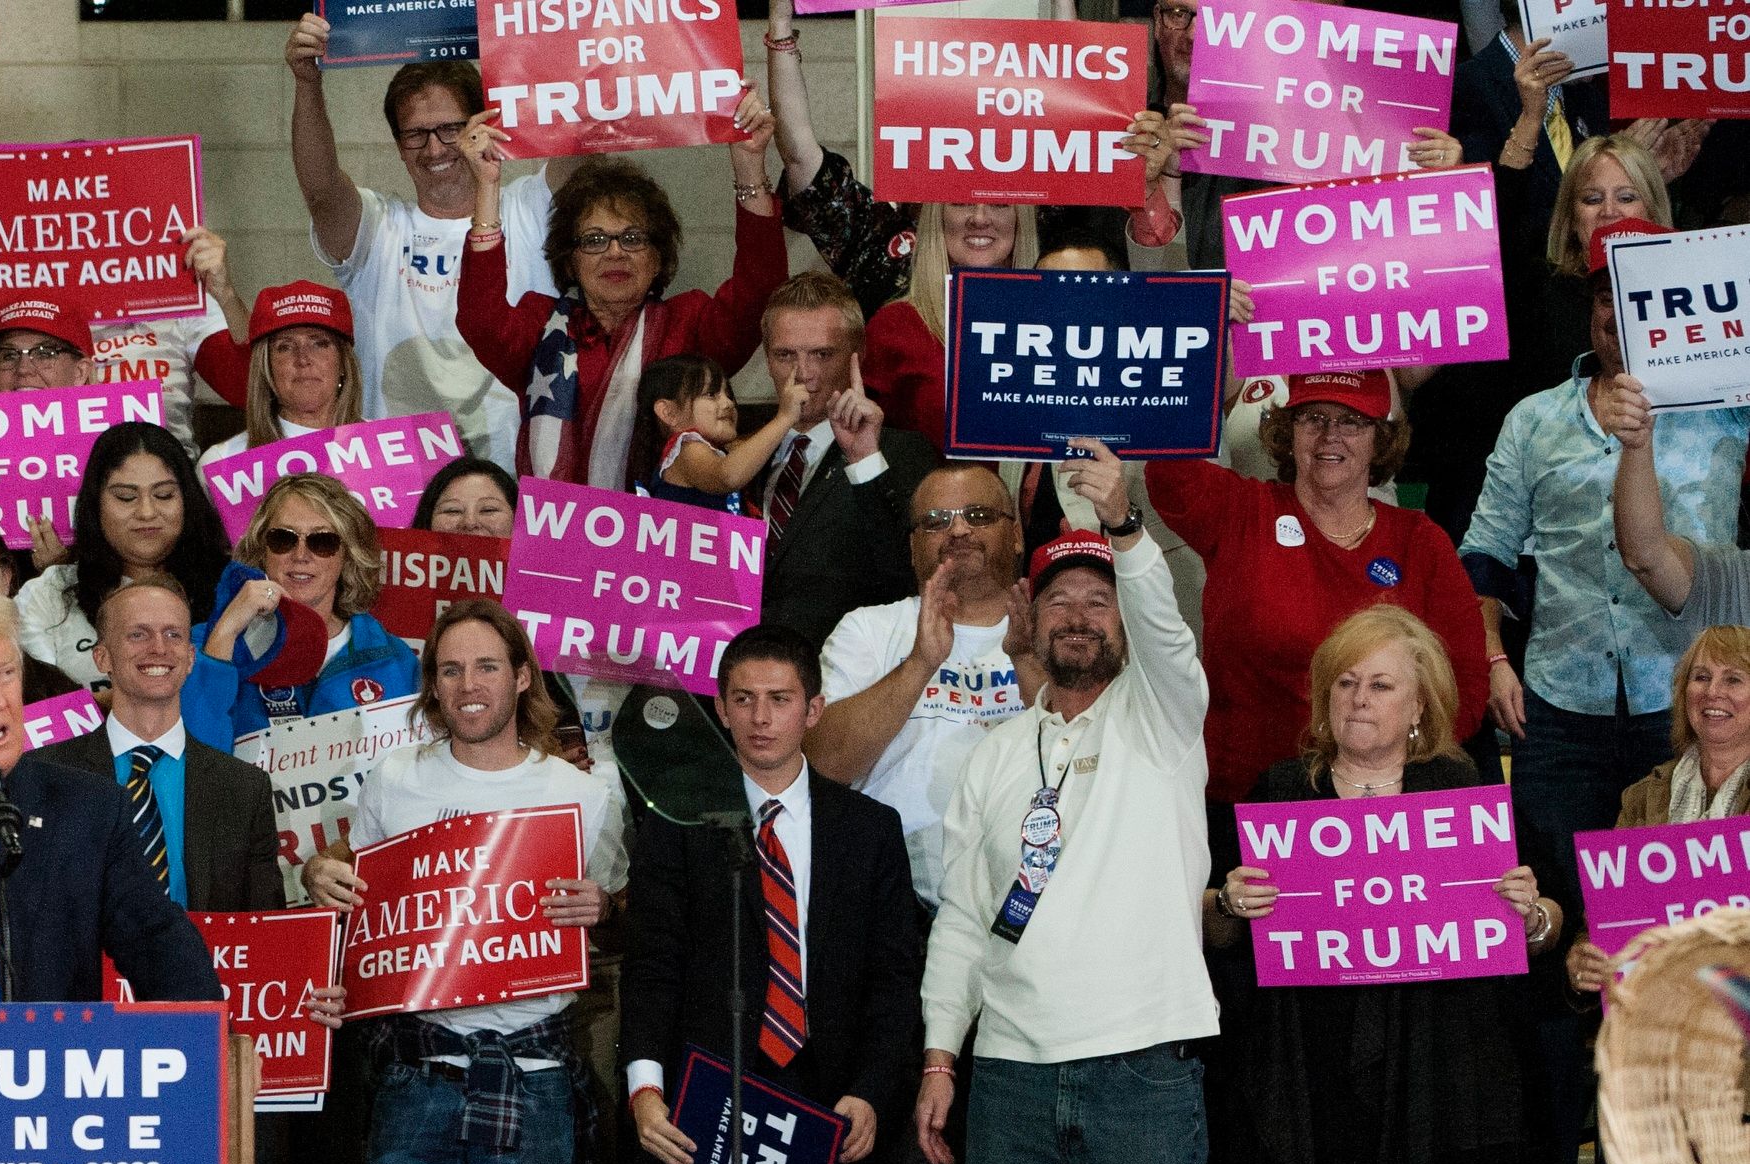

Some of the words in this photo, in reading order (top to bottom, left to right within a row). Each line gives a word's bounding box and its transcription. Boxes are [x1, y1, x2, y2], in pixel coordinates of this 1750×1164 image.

[346, 4, 383, 16] MAKE
[386, 0, 448, 14] AMERICA
[496, 0, 720, 38] HISPANICS
[1202, 5, 1453, 76] WOMEN
[1552, 17, 1588, 34] MAKE
[1708, 14, 1750, 42] FO
[430, 45, 468, 58] 2016
[577, 36, 646, 66] FOR
[893, 40, 1129, 81] HISPANICS
[1613, 52, 1750, 92] TRU
[489, 69, 741, 128] TRUMP
[976, 87, 1044, 117] FOR
[1276, 77, 1364, 115] FOR
[880, 126, 1140, 173] TRUMP
[27, 175, 110, 202] MAKE
[1228, 188, 1495, 252] WOMEN
[79, 254, 178, 284] AGAIN
[1317, 260, 1410, 295] FOR
[0, 302, 20, 317] MAKE
[19, 300, 61, 313] AMERICA
[1, 309, 24, 322] GREAT
[24, 310, 55, 320] AGAIN
[273, 296, 296, 309] MAKE
[297, 294, 333, 307] AMERICA
[276, 305, 303, 317] GREAT
[303, 305, 331, 316] AGAIN
[1628, 281, 1750, 322] TRU
[971, 321, 1210, 359] TRUMP
[1248, 305, 1489, 361] TRUMP
[1648, 319, 1745, 349] PEN
[1648, 355, 1681, 367] MAKE
[1685, 349, 1741, 362] AMERICA
[990, 364, 1184, 388] PENCE
[1305, 374, 1333, 385] GREAT
[1333, 375, 1361, 388] AGAIN
[982, 391, 1021, 404] MAKE
[1025, 393, 1089, 406] AMERICA
[1093, 394, 1139, 407] GREAT
[1142, 393, 1189, 406] AGAIN!
[211, 423, 462, 505] WOMEN
[523, 495, 762, 575] WOMEN
[1047, 541, 1073, 555] MAKE
[593, 571, 682, 610] FOR
[923, 703, 944, 712] MAKE
[980, 706, 1006, 717] GREAT
[1024, 819, 1058, 831] TRUMP
[1242, 801, 1512, 860] WOMEN
[413, 846, 490, 880] MAKE
[1580, 827, 1750, 890] WOM
[1009, 897, 1033, 913] TRUMP
[1335, 874, 1428, 907] FOR
[359, 941, 450, 979] GREAT
[460, 928, 562, 967] AGAIN
[1268, 918, 1507, 971] TRUMP
[717, 1096, 733, 1134] MAKE
